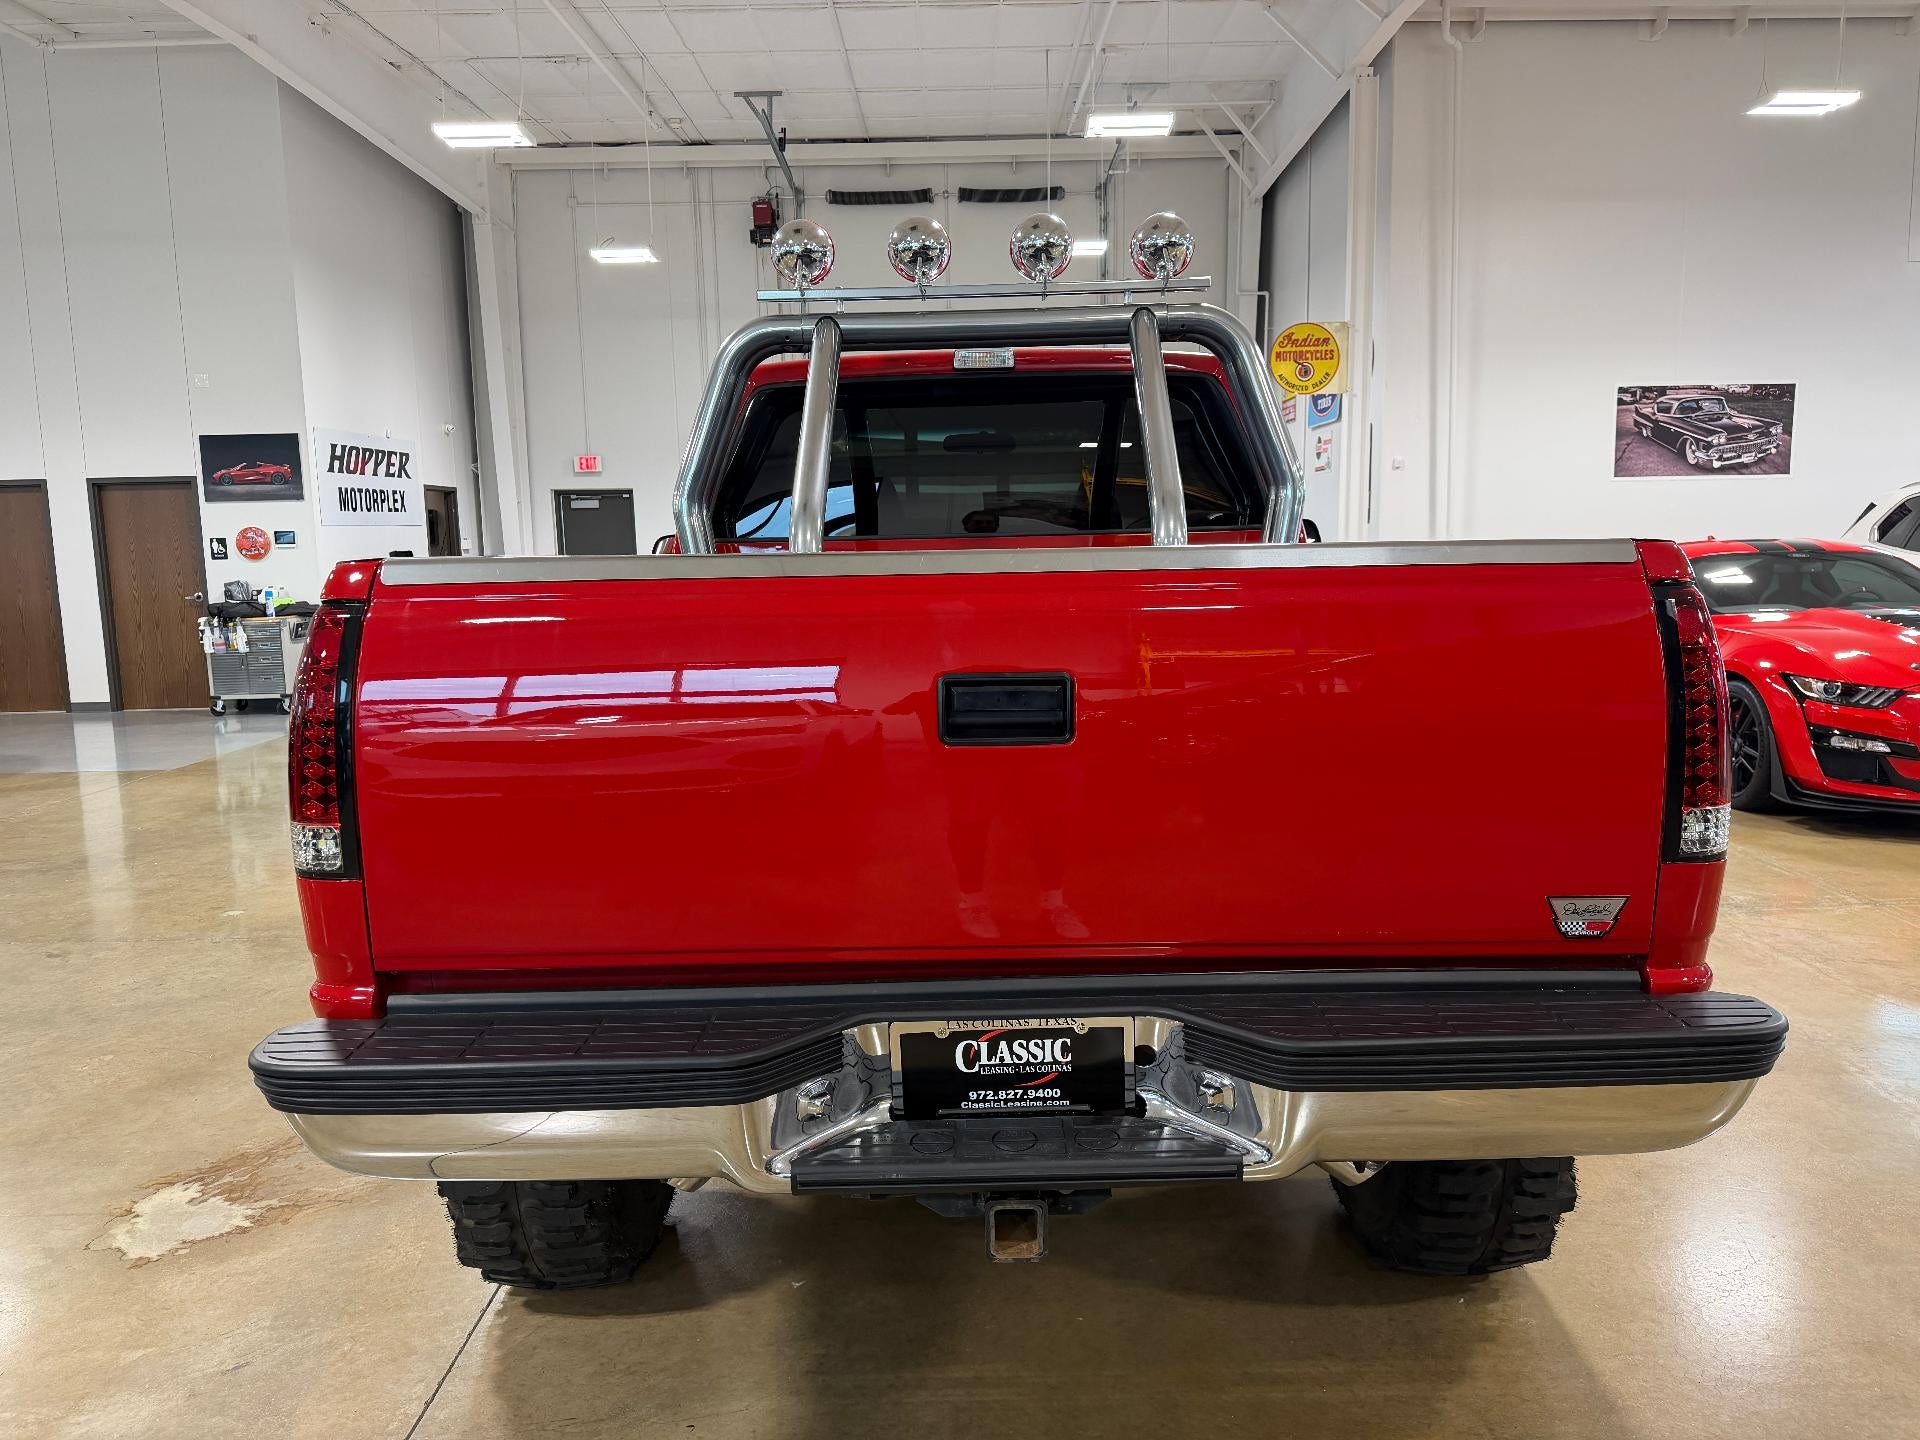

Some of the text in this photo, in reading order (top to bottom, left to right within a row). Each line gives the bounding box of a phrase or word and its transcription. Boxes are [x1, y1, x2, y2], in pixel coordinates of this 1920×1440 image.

[1278, 332, 1331, 348] Indian
[1275, 349, 1335, 362] MOTORCYCLES
[1278, 371, 1331, 391] AUTHORIZED DEALER
[327, 443, 412, 479] HOPPER
[579, 456, 597, 471] EXIT
[338, 486, 407, 513] MOTORPLEX
[947, 1019, 969, 1030] LAS
[1035, 1017, 1078, 1027] TEXAS
[955, 1038, 1072, 1073] CLASSIC
[980, 1064, 1071, 1074] LEASING LAS COLINAS
[968, 1088, 1061, 1100] 972.827.9400
[960, 1100, 1070, 1109] ClassicLeasing.com
